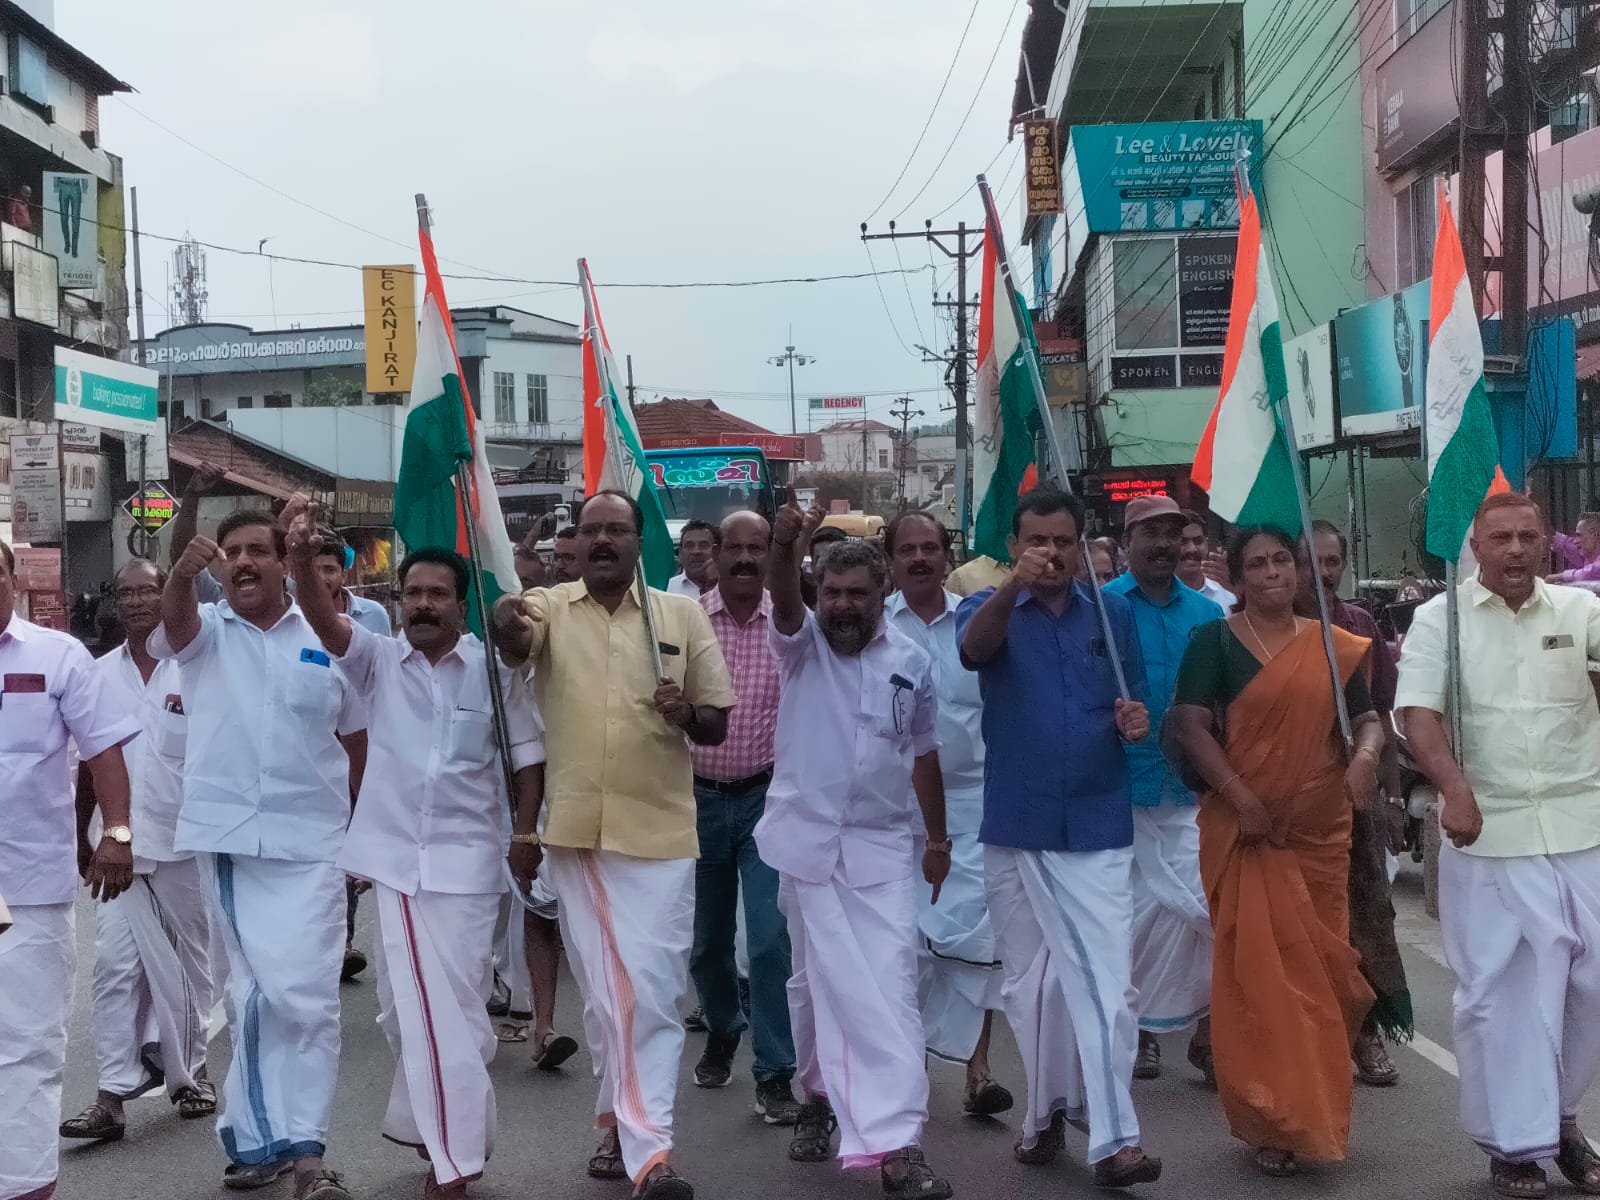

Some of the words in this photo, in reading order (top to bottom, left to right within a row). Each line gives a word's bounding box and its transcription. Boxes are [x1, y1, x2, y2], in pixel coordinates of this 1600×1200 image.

[1115, 135, 1155, 155] Lee
[1159, 135, 1172, 152] &
[1180, 131, 1254, 152] Lovely
[1144, 152, 1184, 164] BEAUTY
[1185, 254, 1232, 266] SPOKEN
[1182, 269, 1235, 282] ENGLISH
[1040, 354, 1078, 364] DVOCATE
[1120, 367, 1170, 378] SPOKEN
[824, 396, 864, 408] REGENCY
